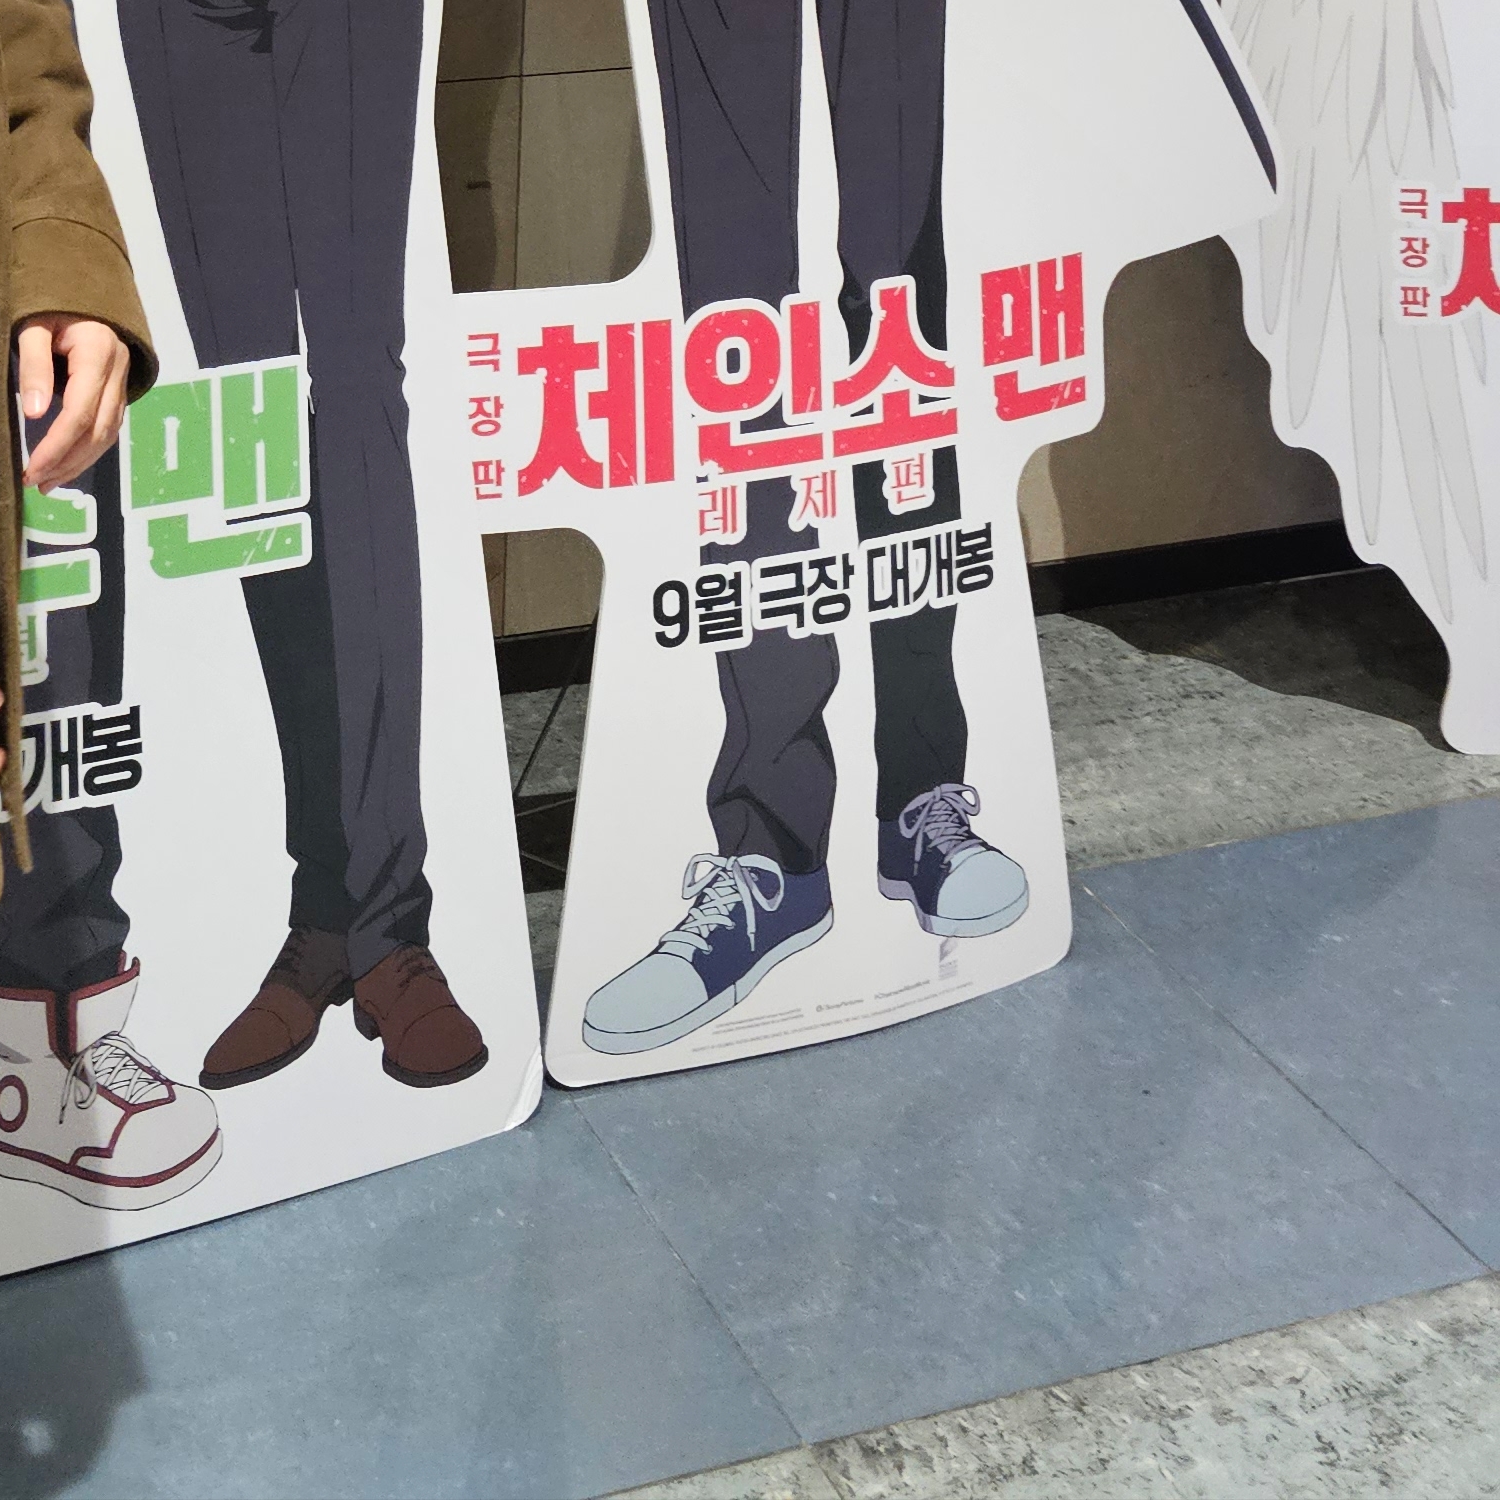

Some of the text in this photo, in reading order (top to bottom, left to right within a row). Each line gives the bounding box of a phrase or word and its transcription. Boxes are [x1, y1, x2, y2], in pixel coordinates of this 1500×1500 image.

[517, 253, 1087, 498] 체인소 맨
[130, 366, 303, 580] 맨
[653, 522, 995, 648] 9월 극장 대개봉
[21, 705, 143, 802] 개봉
